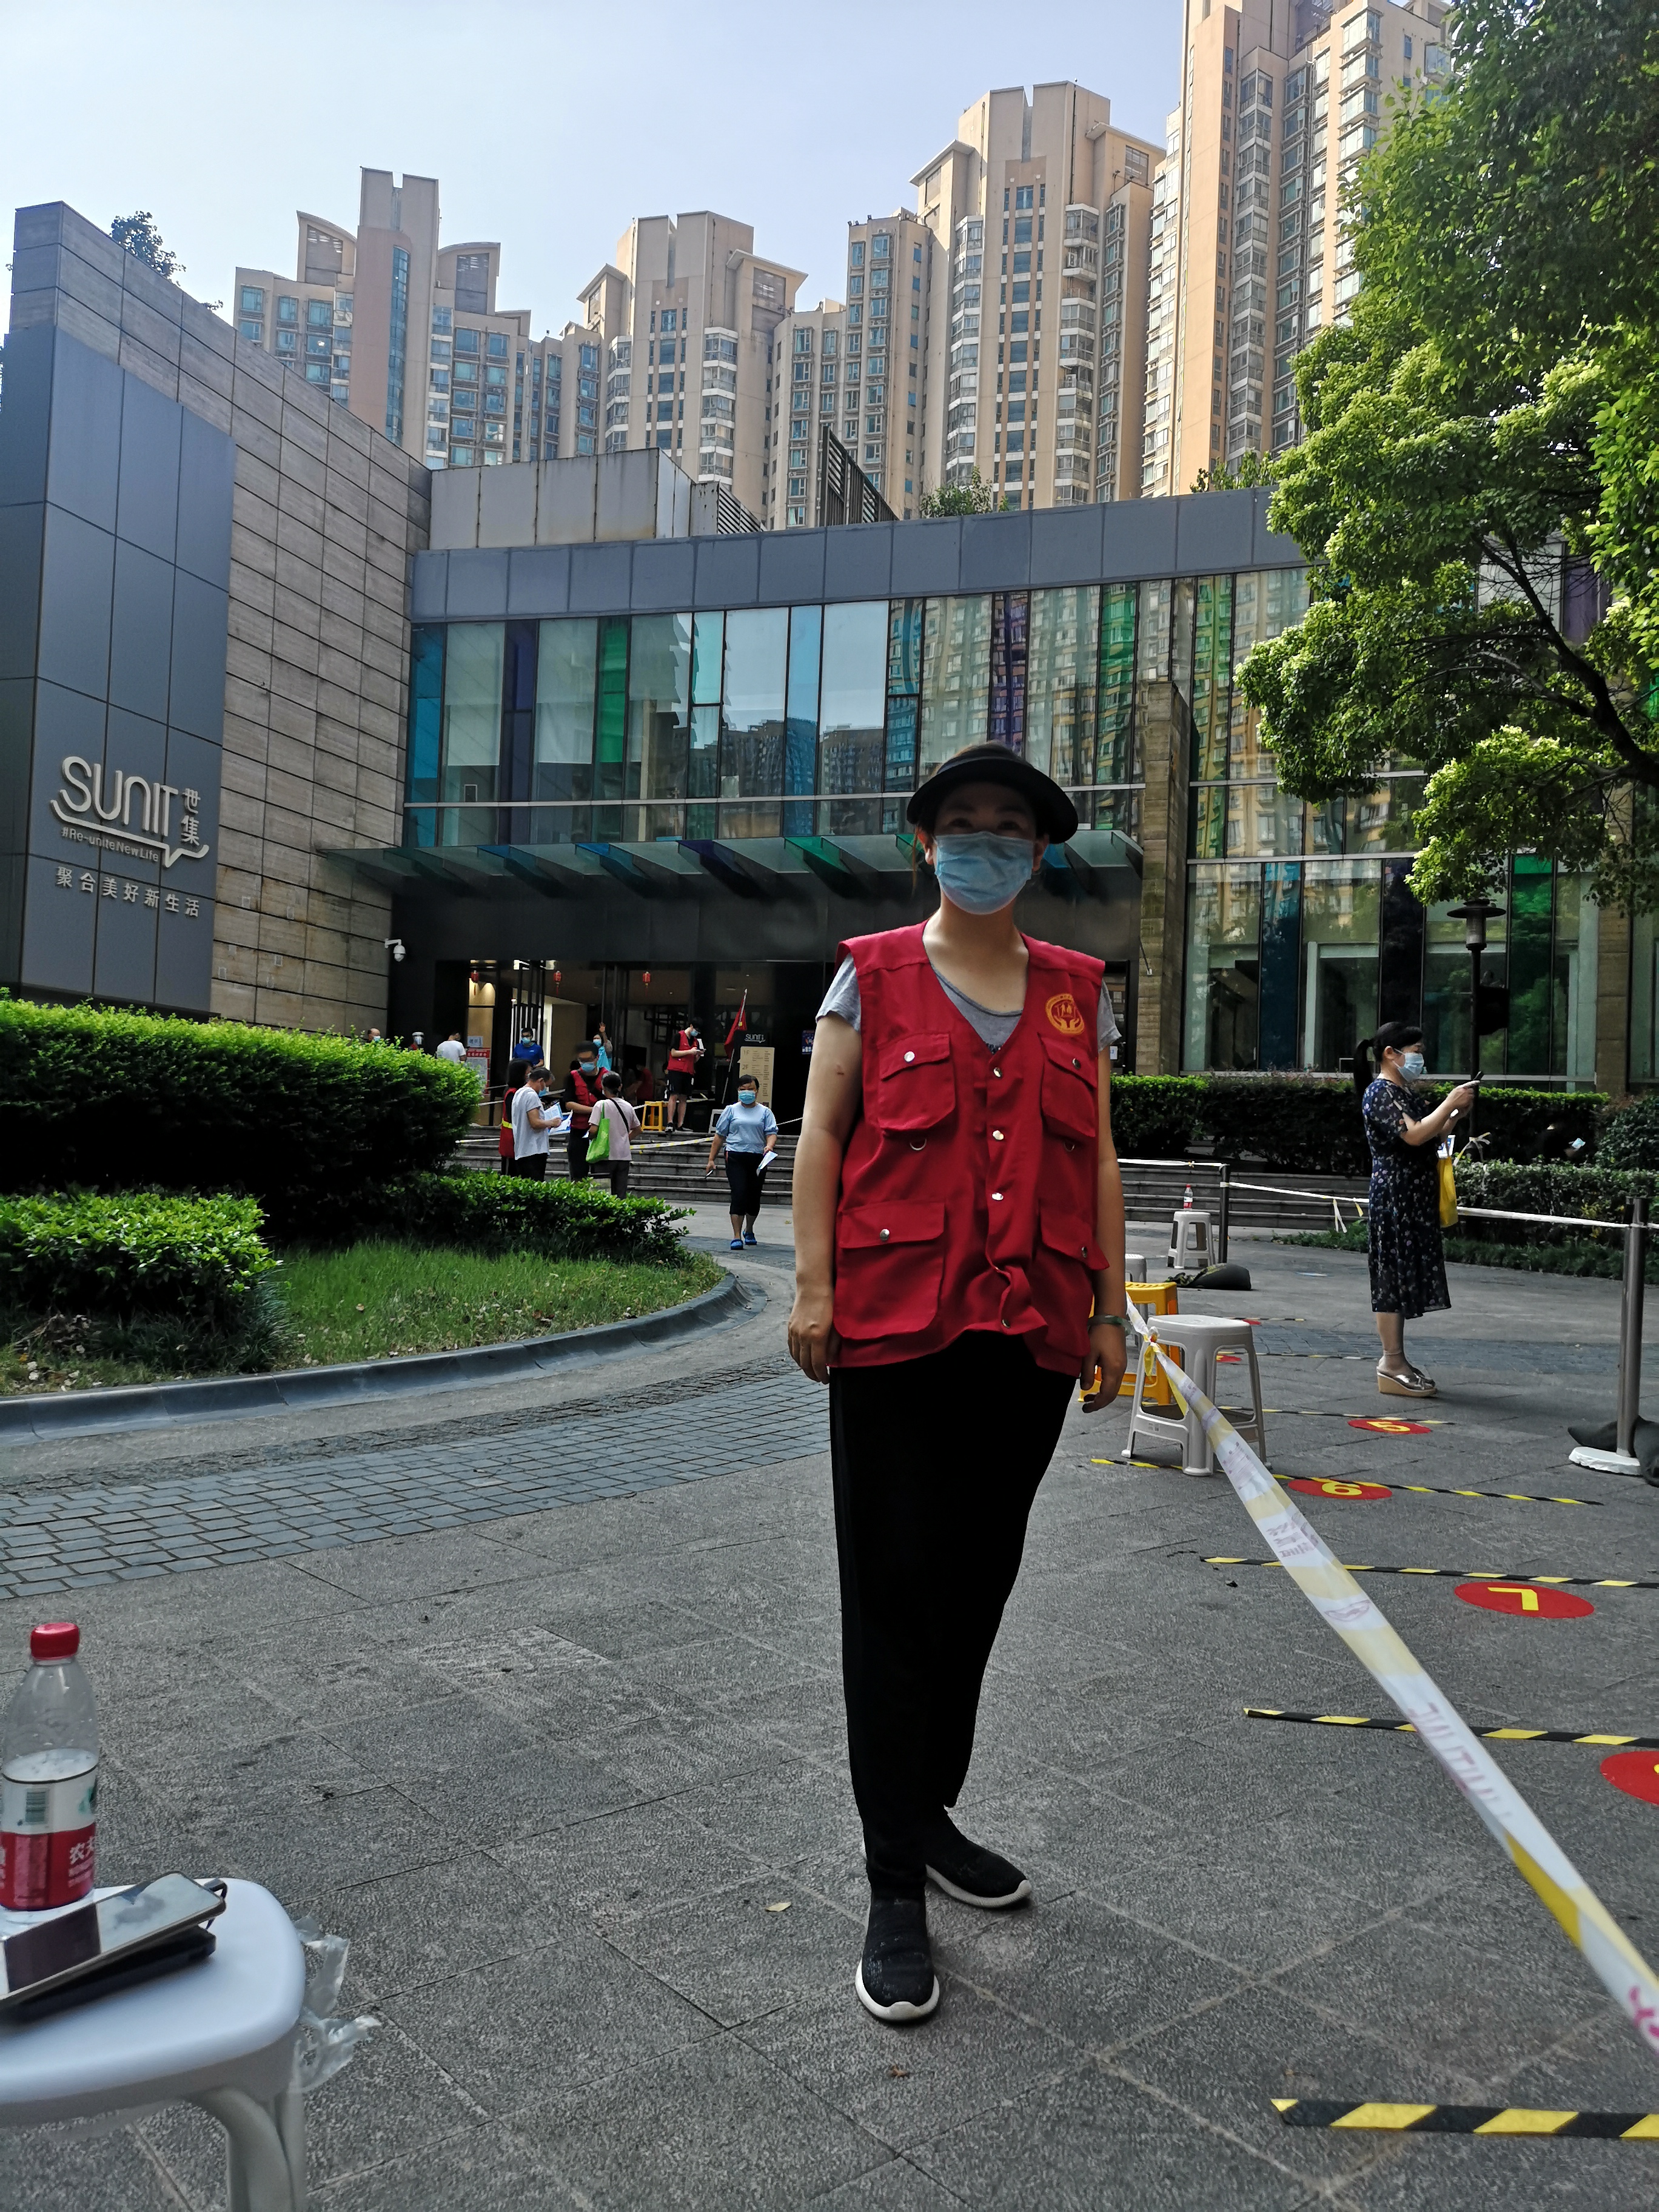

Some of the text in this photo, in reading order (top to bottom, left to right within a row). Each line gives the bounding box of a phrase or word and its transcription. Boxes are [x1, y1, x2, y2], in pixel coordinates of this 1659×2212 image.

[181, 788, 200, 845] 世集
[56, 866, 199, 917] 聚合美好新生活
[1367, 1421, 1410, 1432] 5
[1322, 1481, 1362, 1495] 6
[1487, 1587, 1539, 1611] 7
